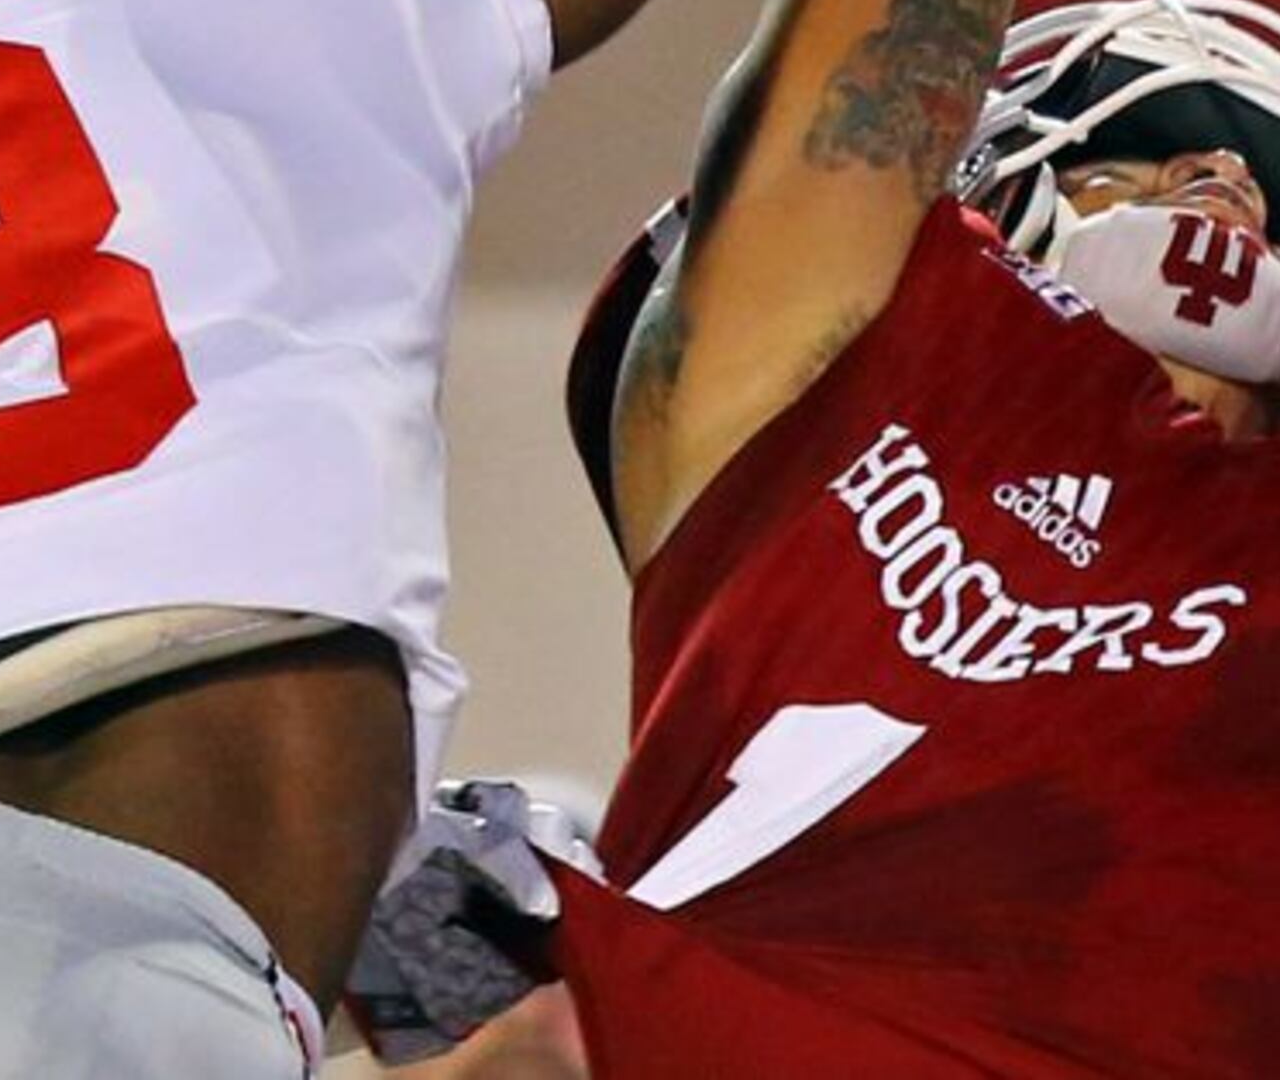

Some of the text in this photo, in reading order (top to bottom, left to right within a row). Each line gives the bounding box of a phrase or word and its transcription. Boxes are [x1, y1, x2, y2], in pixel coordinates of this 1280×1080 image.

[827, 422, 1247, 683] HOOSIERS
[992, 482, 1102, 569] adidas
[624, 703, 929, 911] 1
